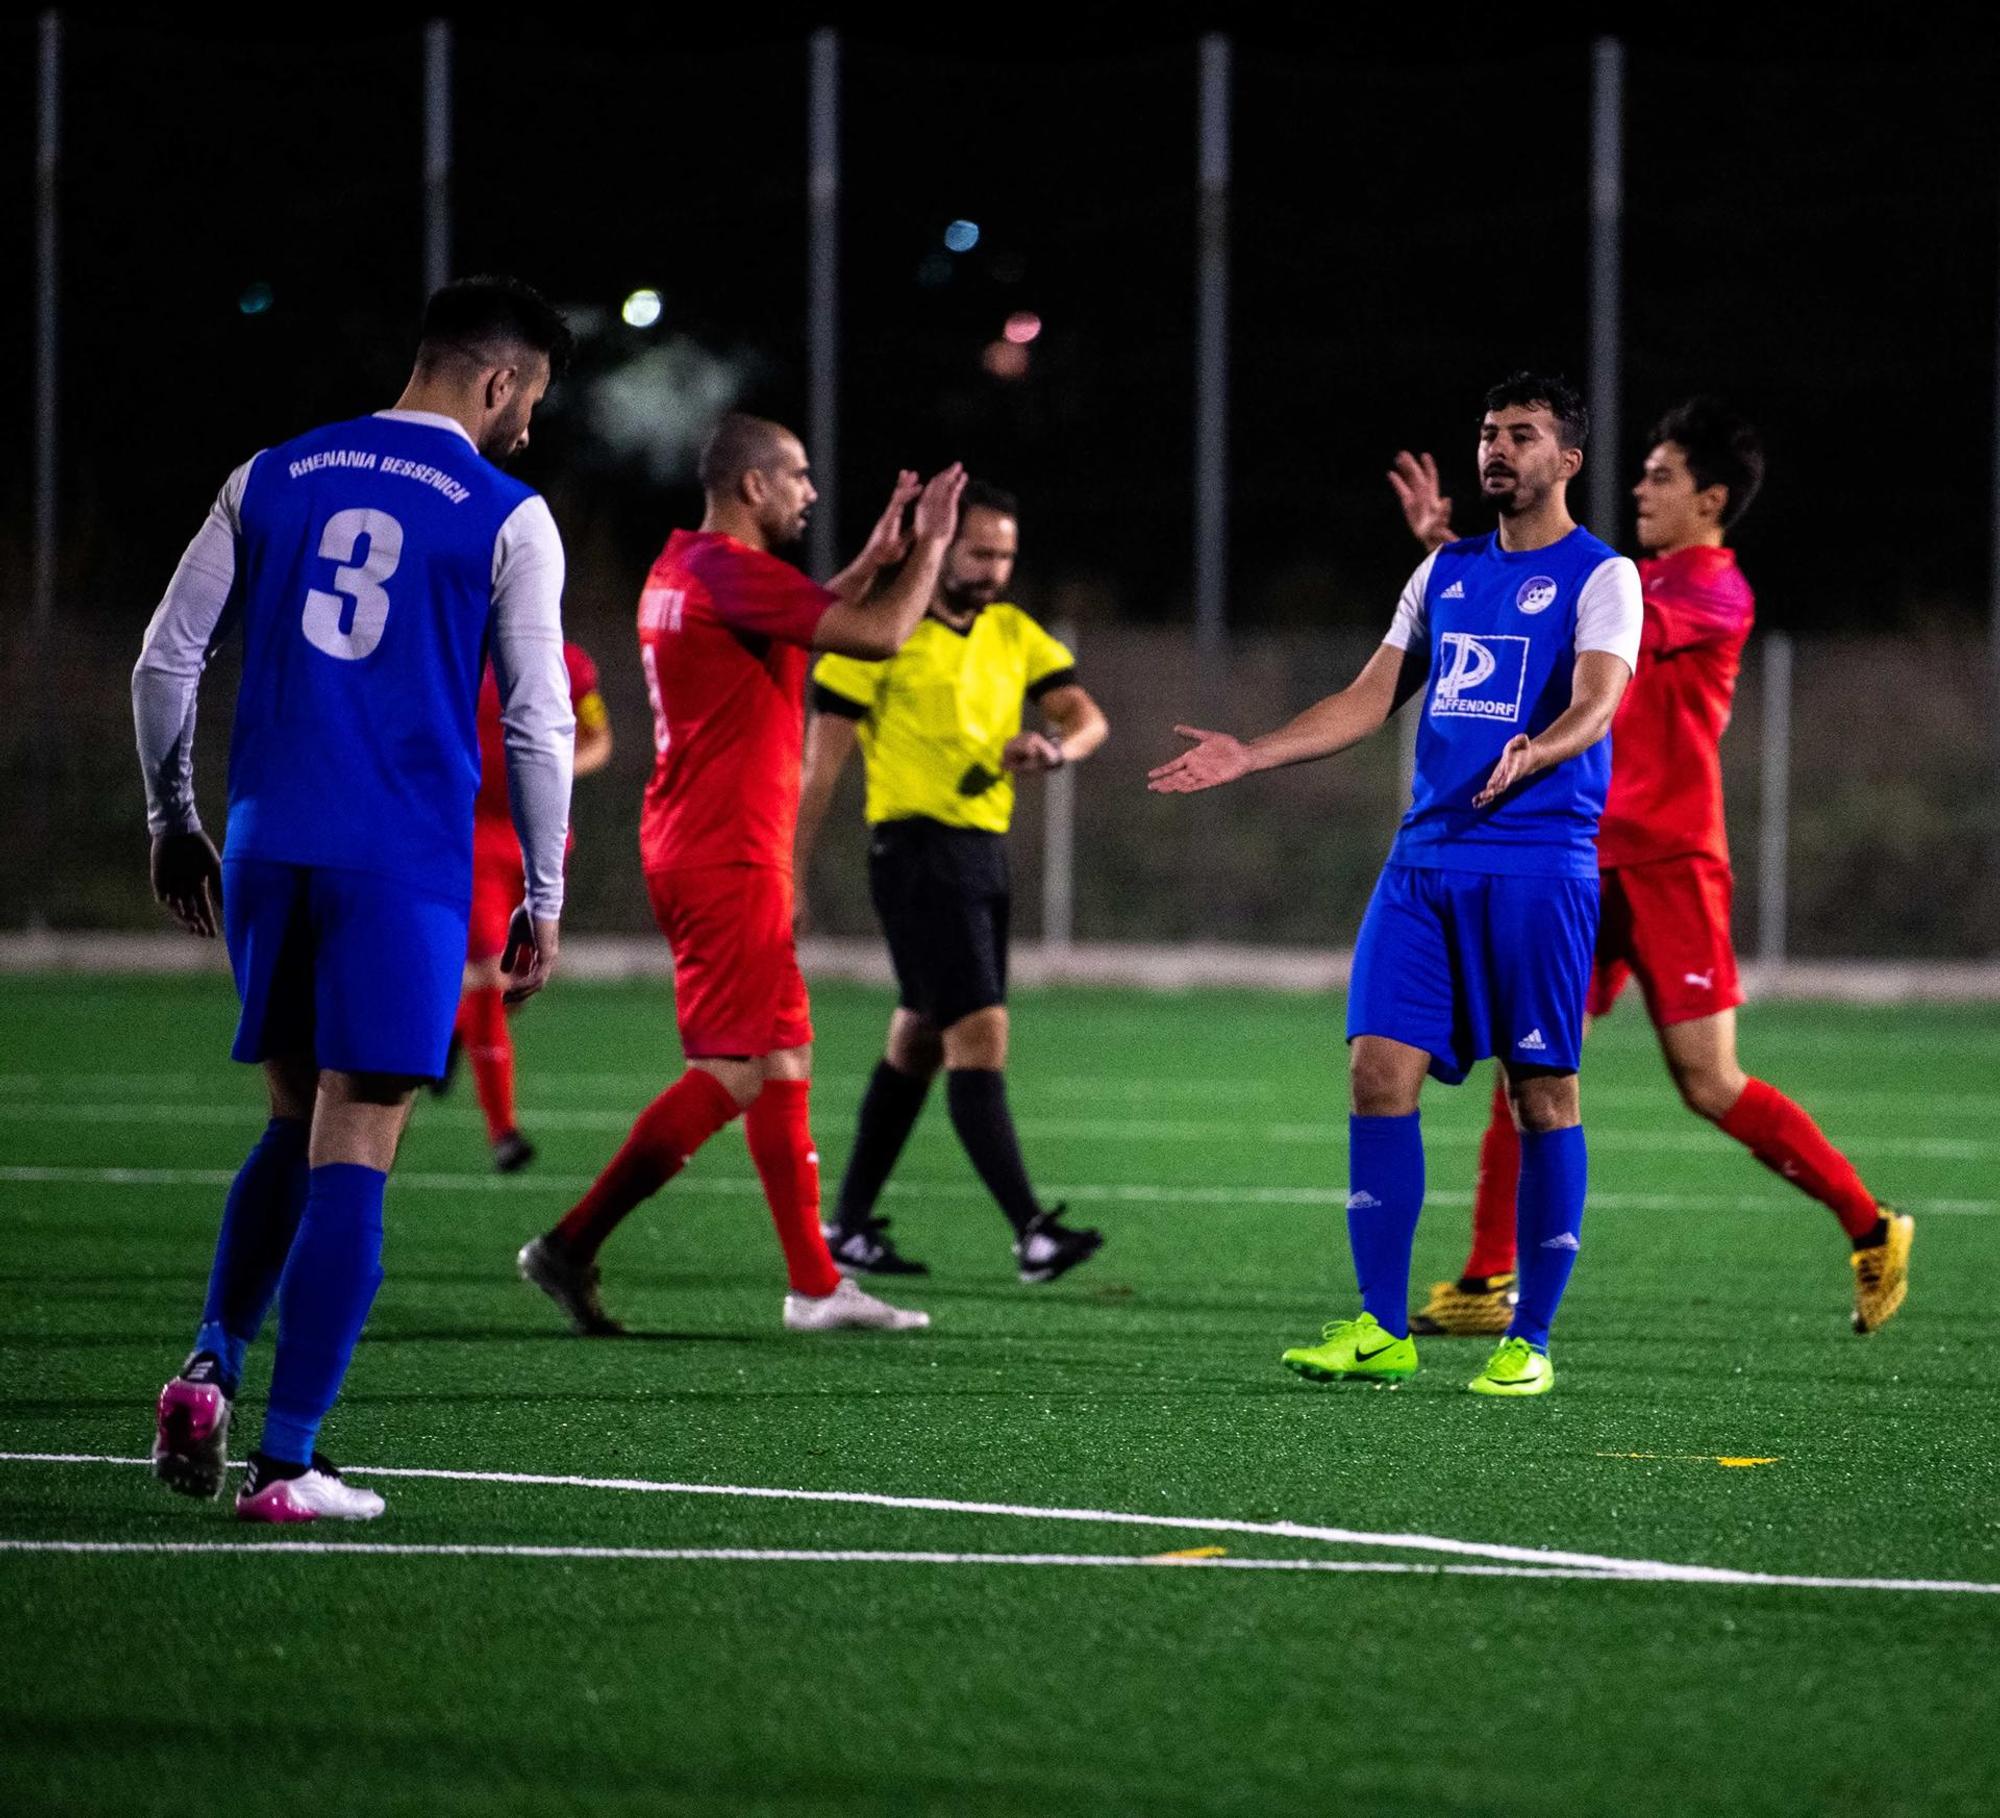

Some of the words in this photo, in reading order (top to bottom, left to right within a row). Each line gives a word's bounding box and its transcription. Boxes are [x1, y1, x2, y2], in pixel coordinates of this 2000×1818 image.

[289, 450, 376, 479] RHENANIA
[380, 456, 470, 504] BESSENICH
[302, 508, 404, 660] 3
